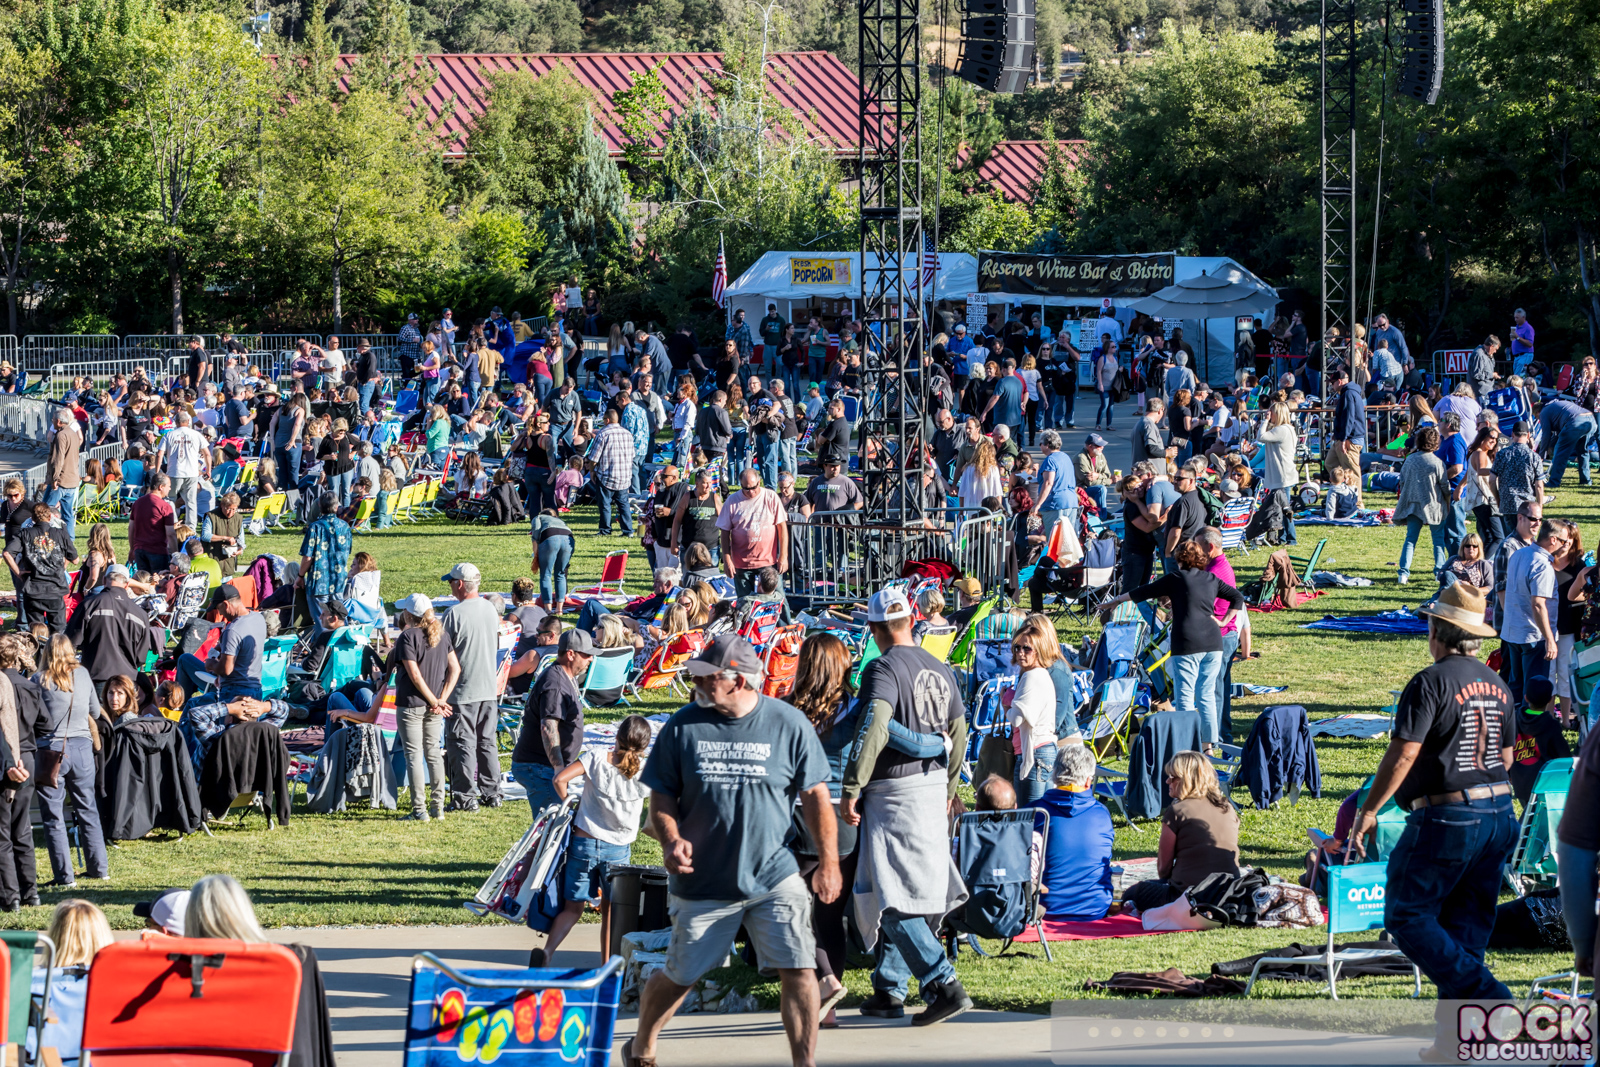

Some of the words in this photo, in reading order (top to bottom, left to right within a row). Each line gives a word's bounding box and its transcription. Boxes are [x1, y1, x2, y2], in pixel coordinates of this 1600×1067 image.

[793, 266, 833, 283] POPCORN
[981, 258, 1034, 279] Reserve
[1036, 258, 1076, 279] Wine
[1079, 261, 1108, 280] Bar
[1109, 265, 1124, 281] &
[1127, 261, 1173, 280] Bistro
[1447, 352, 1472, 371] ATM
[696, 740, 732, 754] KENNEDY
[732, 742, 771, 758] MEADOWS
[1348, 883, 1386, 902] arub
